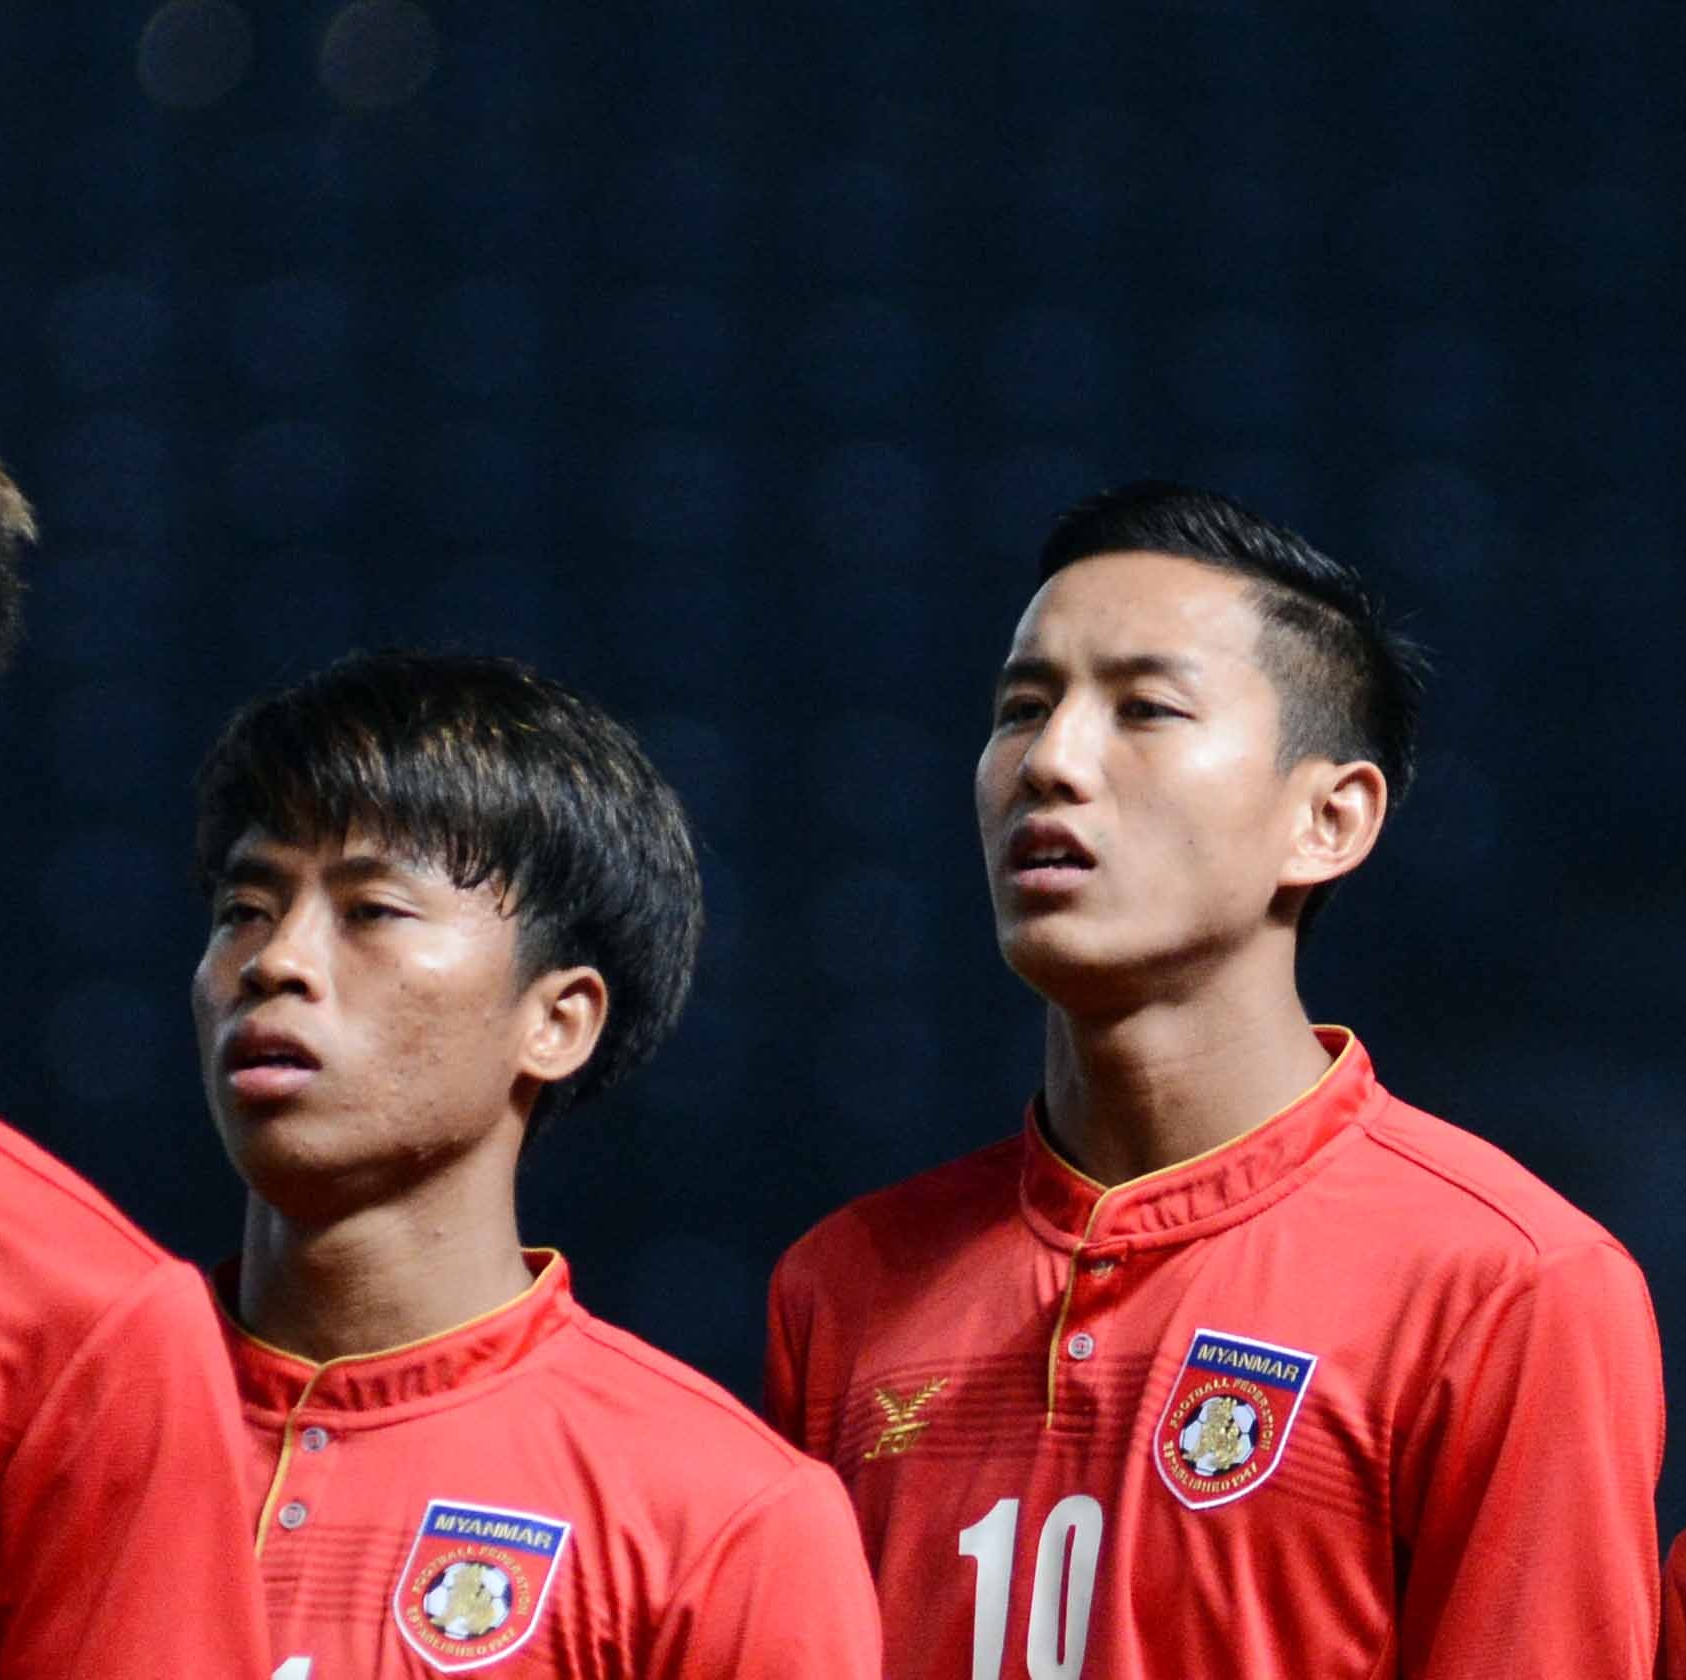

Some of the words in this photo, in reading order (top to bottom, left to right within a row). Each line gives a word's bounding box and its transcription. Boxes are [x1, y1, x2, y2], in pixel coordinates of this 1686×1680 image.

[1197, 1343, 1300, 1382] MYANMAR
[1170, 1377, 1230, 1429] FOOTBALL
[434, 1513, 553, 1549] MYANMAR
